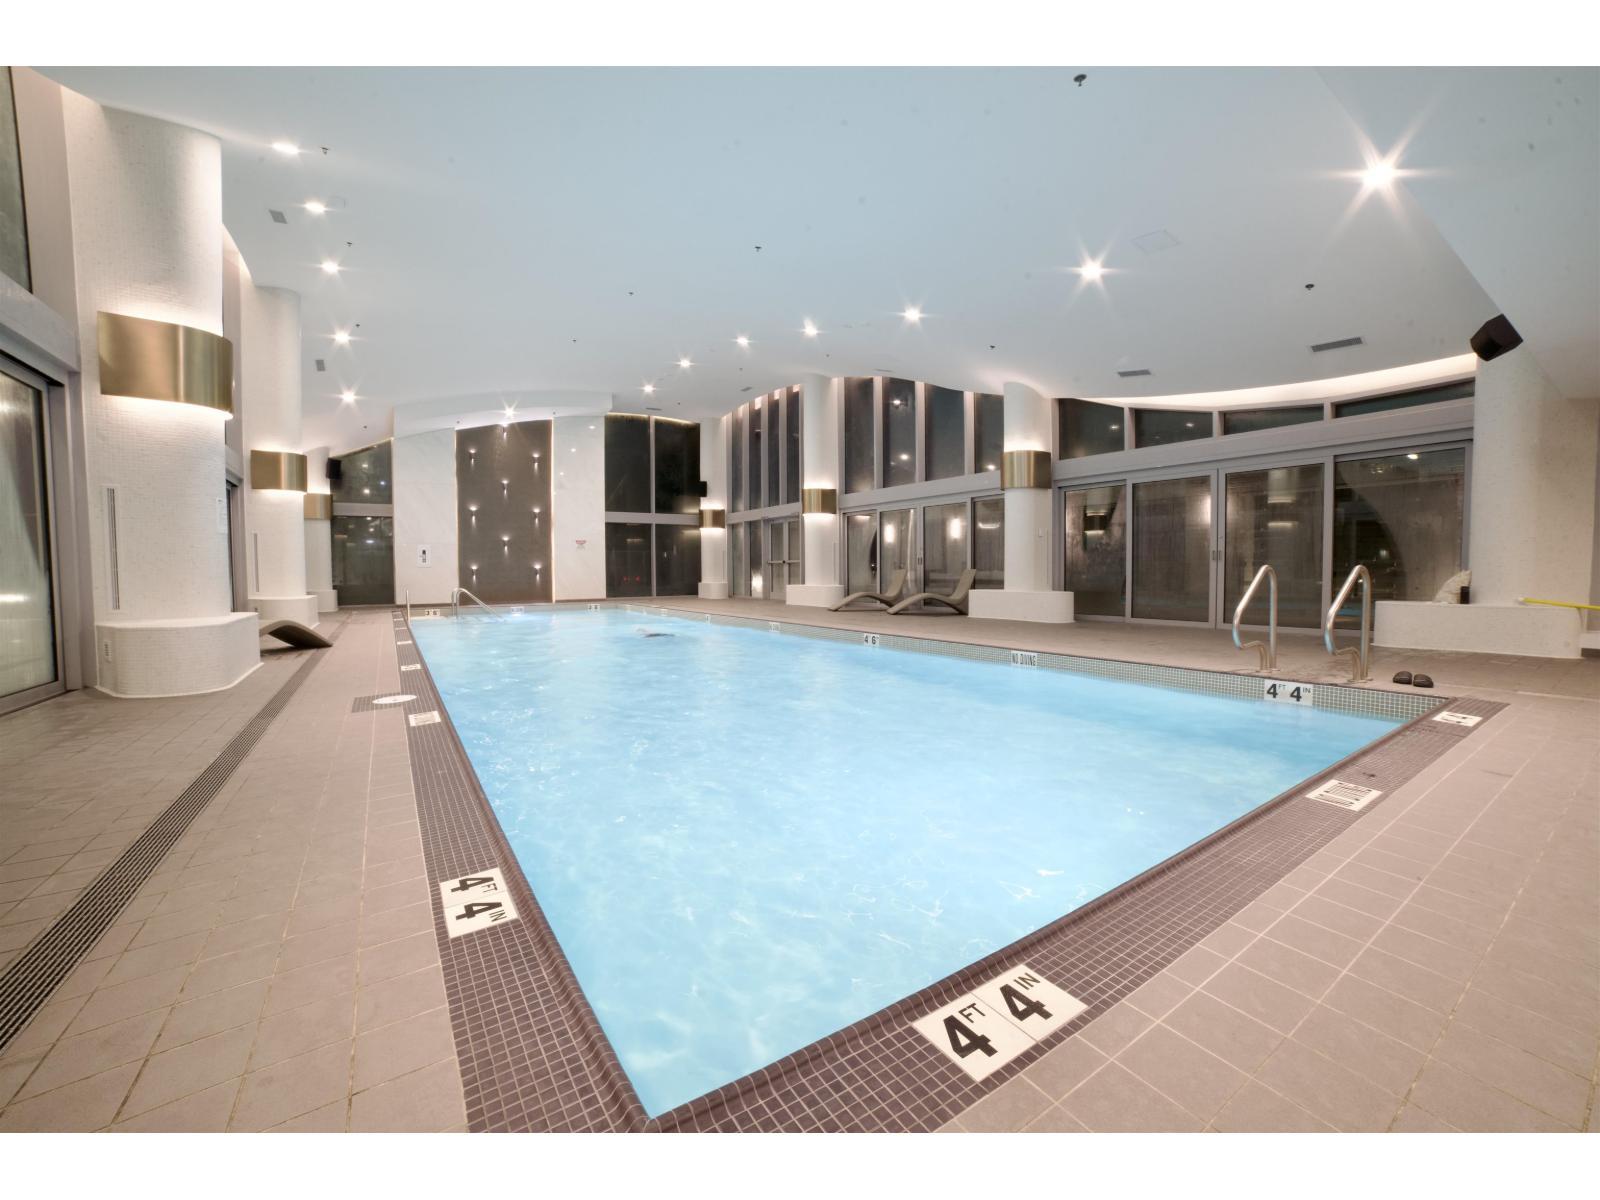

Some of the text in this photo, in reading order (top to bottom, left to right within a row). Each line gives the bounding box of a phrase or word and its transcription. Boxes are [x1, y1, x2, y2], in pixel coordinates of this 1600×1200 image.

[1266, 683, 1278, 699] 4
[1290, 686, 1302, 702] 4
[451, 877, 498, 893] 4 FT
[456, 902, 508, 922] 4 IN
[943, 972, 1053, 1059] 4 FT 4 IN
